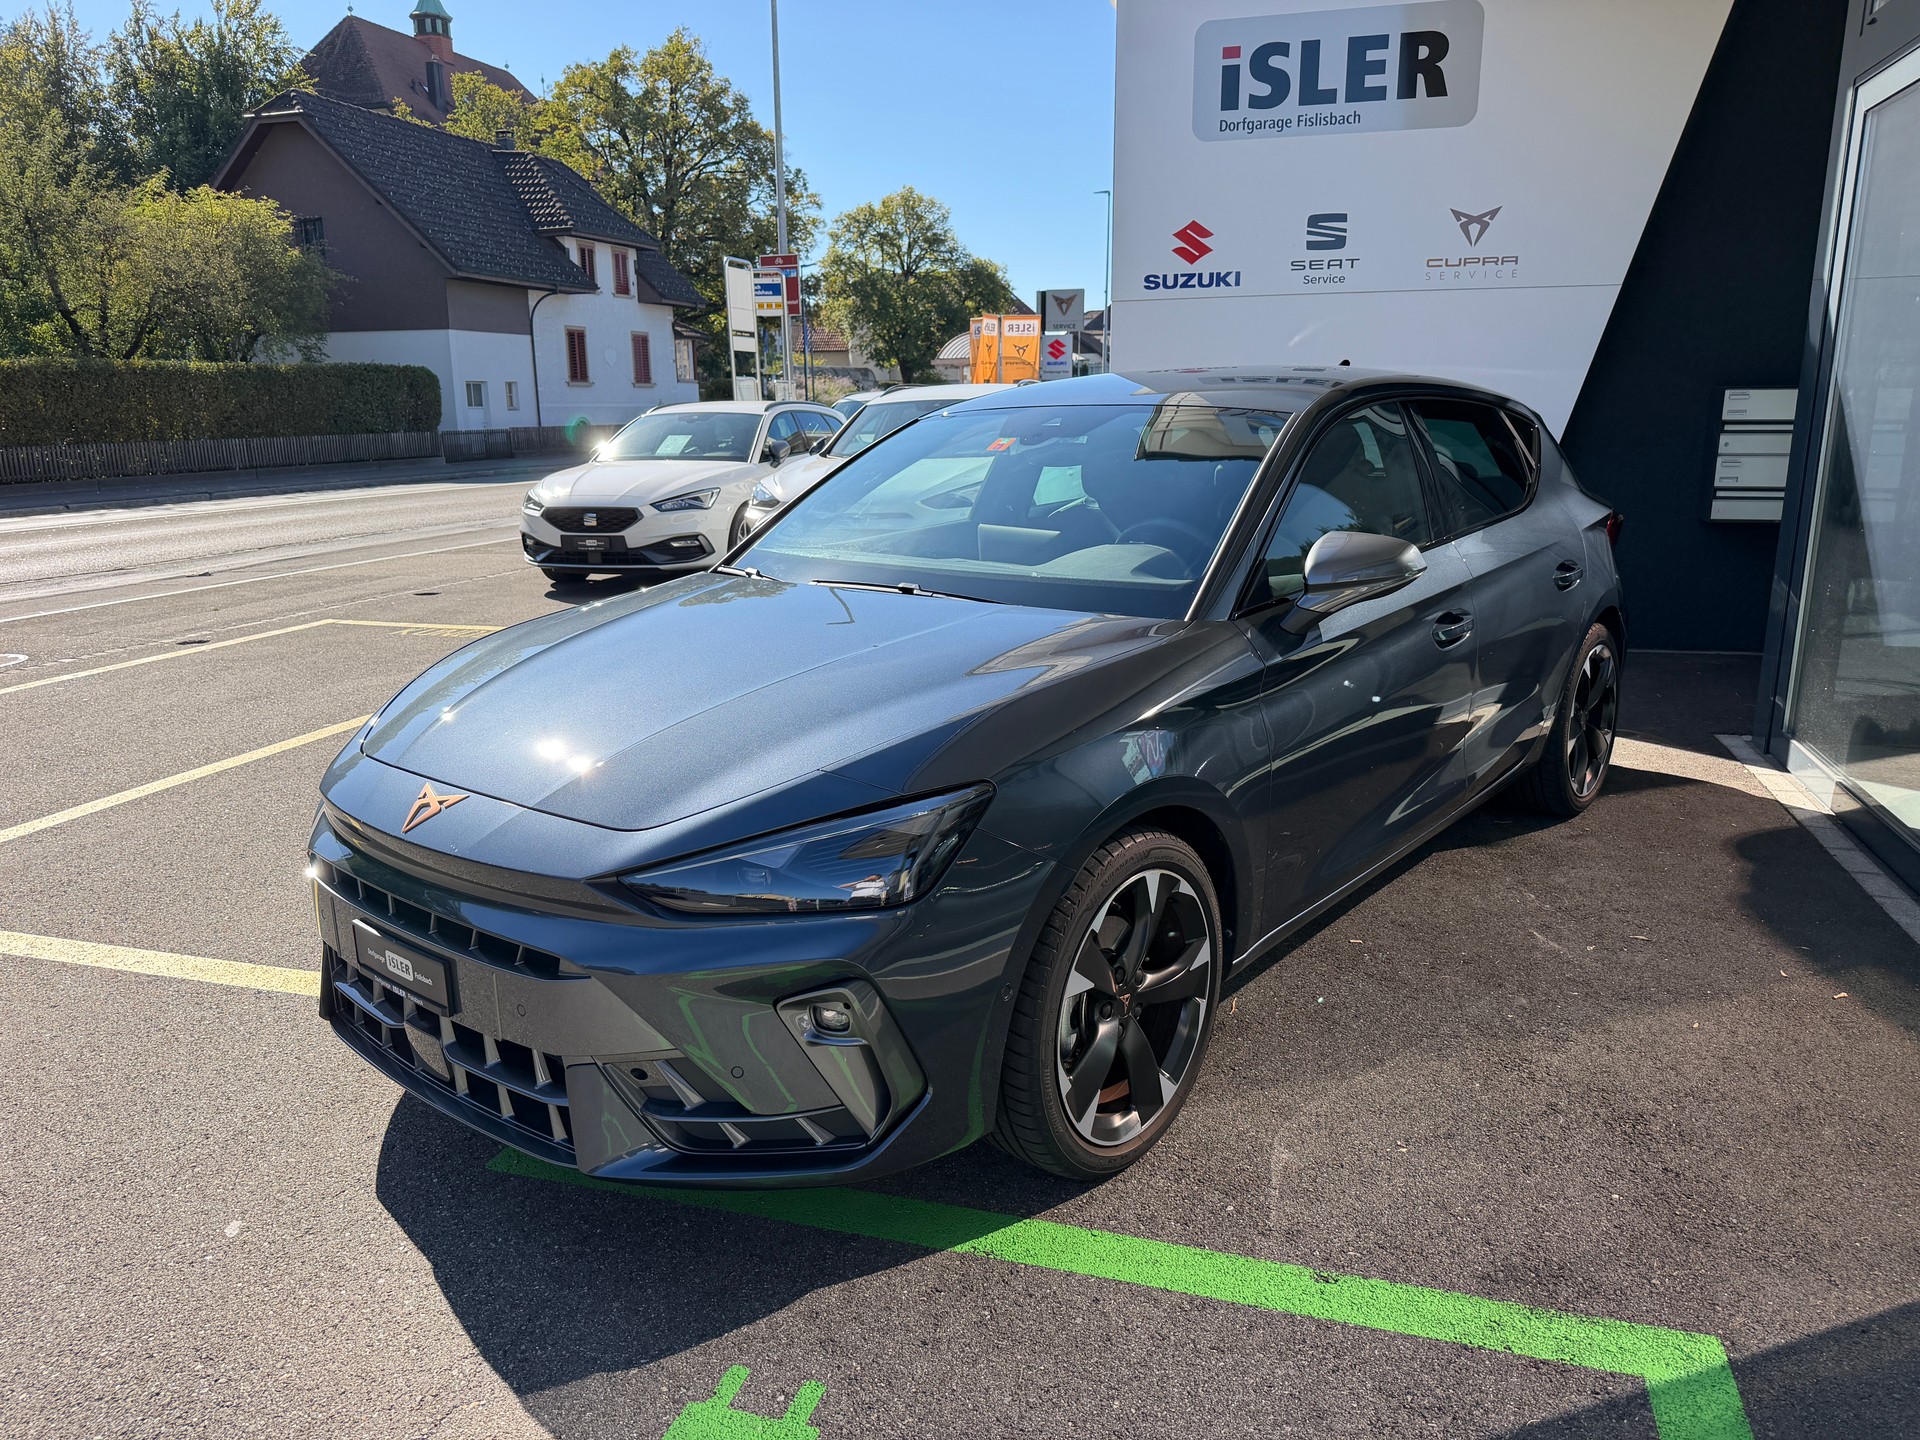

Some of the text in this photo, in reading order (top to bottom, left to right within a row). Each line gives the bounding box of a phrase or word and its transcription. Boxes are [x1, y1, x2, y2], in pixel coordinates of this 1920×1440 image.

[1220, 30, 1450, 112] iSLER
[1219, 110, 1361, 135] Dorfgarage Fislisbach
[1290, 257, 1360, 271] SEAT
[1426, 255, 1519, 268] CUPRA
[1143, 270, 1241, 290] SUZUKI
[1303, 273, 1346, 285] Service
[1425, 269, 1519, 281] SERVICE
